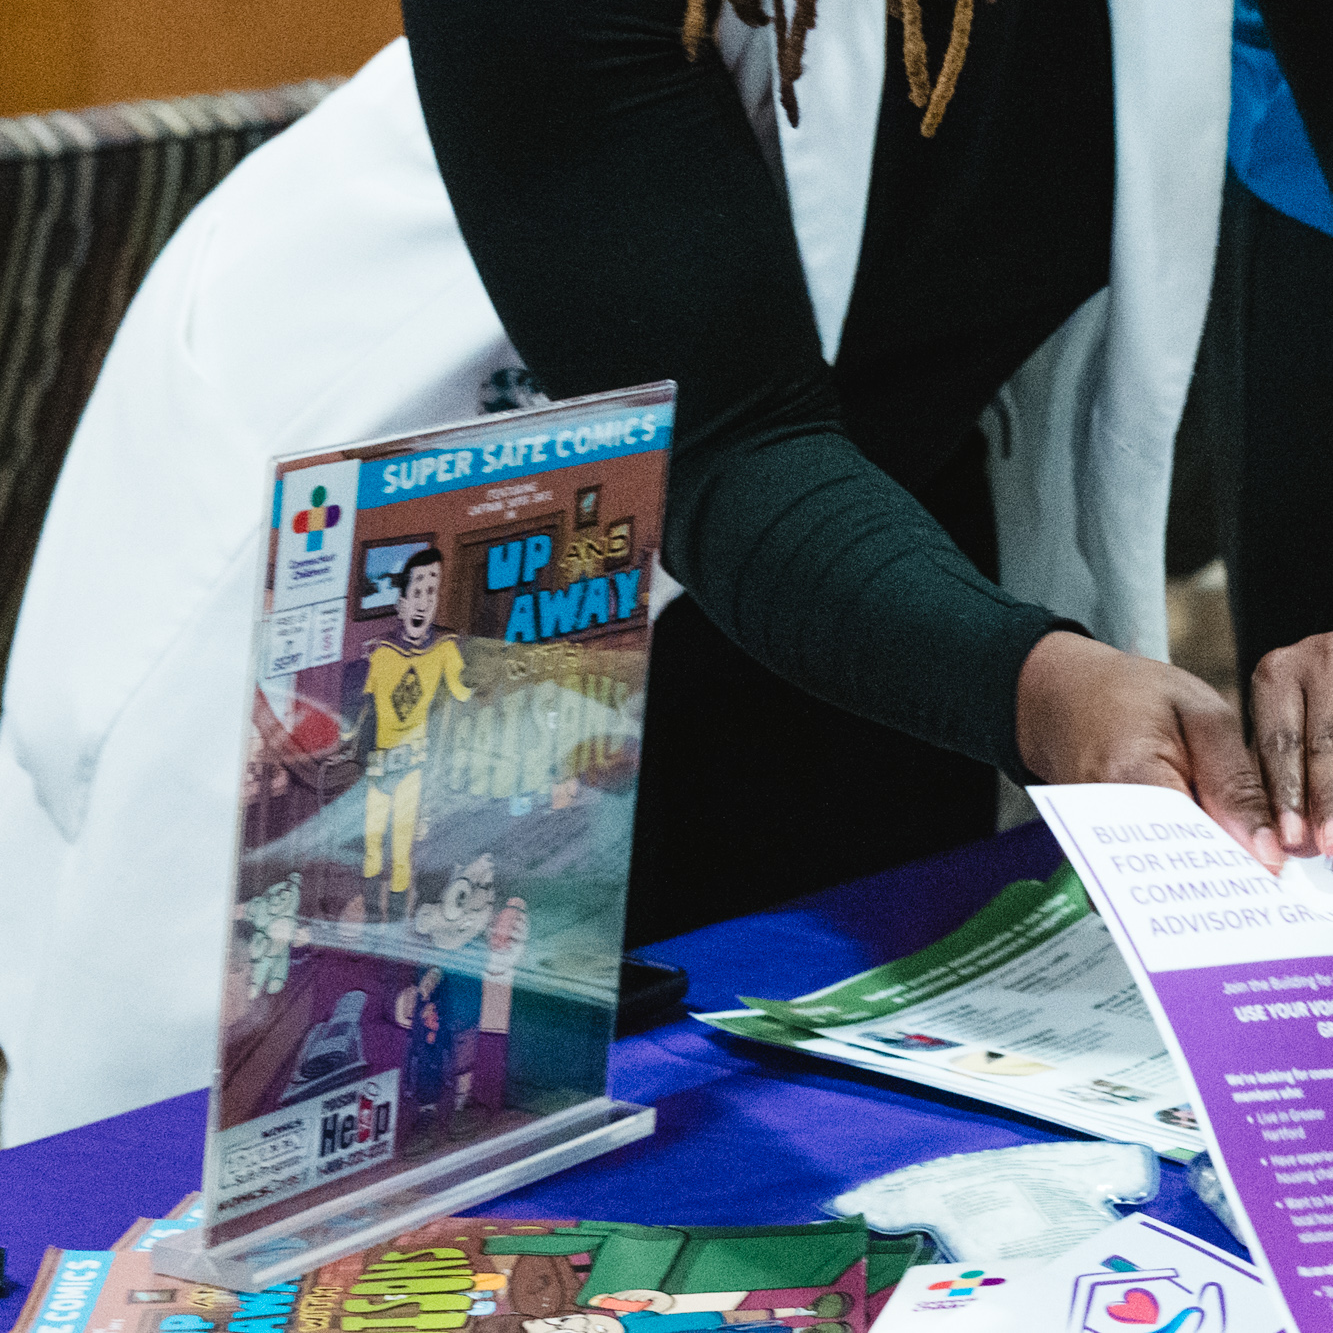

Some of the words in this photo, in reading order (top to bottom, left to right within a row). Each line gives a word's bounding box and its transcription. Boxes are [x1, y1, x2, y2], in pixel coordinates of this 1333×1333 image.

[382, 451, 472, 494] SUPER
[481, 435, 548, 473] SAFE
[555, 414, 657, 458] COMICS
[487, 534, 552, 591] UP
[504, 569, 640, 644] AWAY
[1091, 822, 1215, 844] BUILDING
[1110, 853, 1164, 874] FOR
[1168, 849, 1255, 869] HEALTH
[1130, 877, 1283, 905] COMMUNITY
[1150, 906, 1273, 936] ADVISORY
[1233, 1004, 1269, 1022] USE
[1264, 1001, 1310, 1019] YOUR
[44, 1259, 102, 1323] COMICS
[342, 1247, 474, 1333] ISONS
